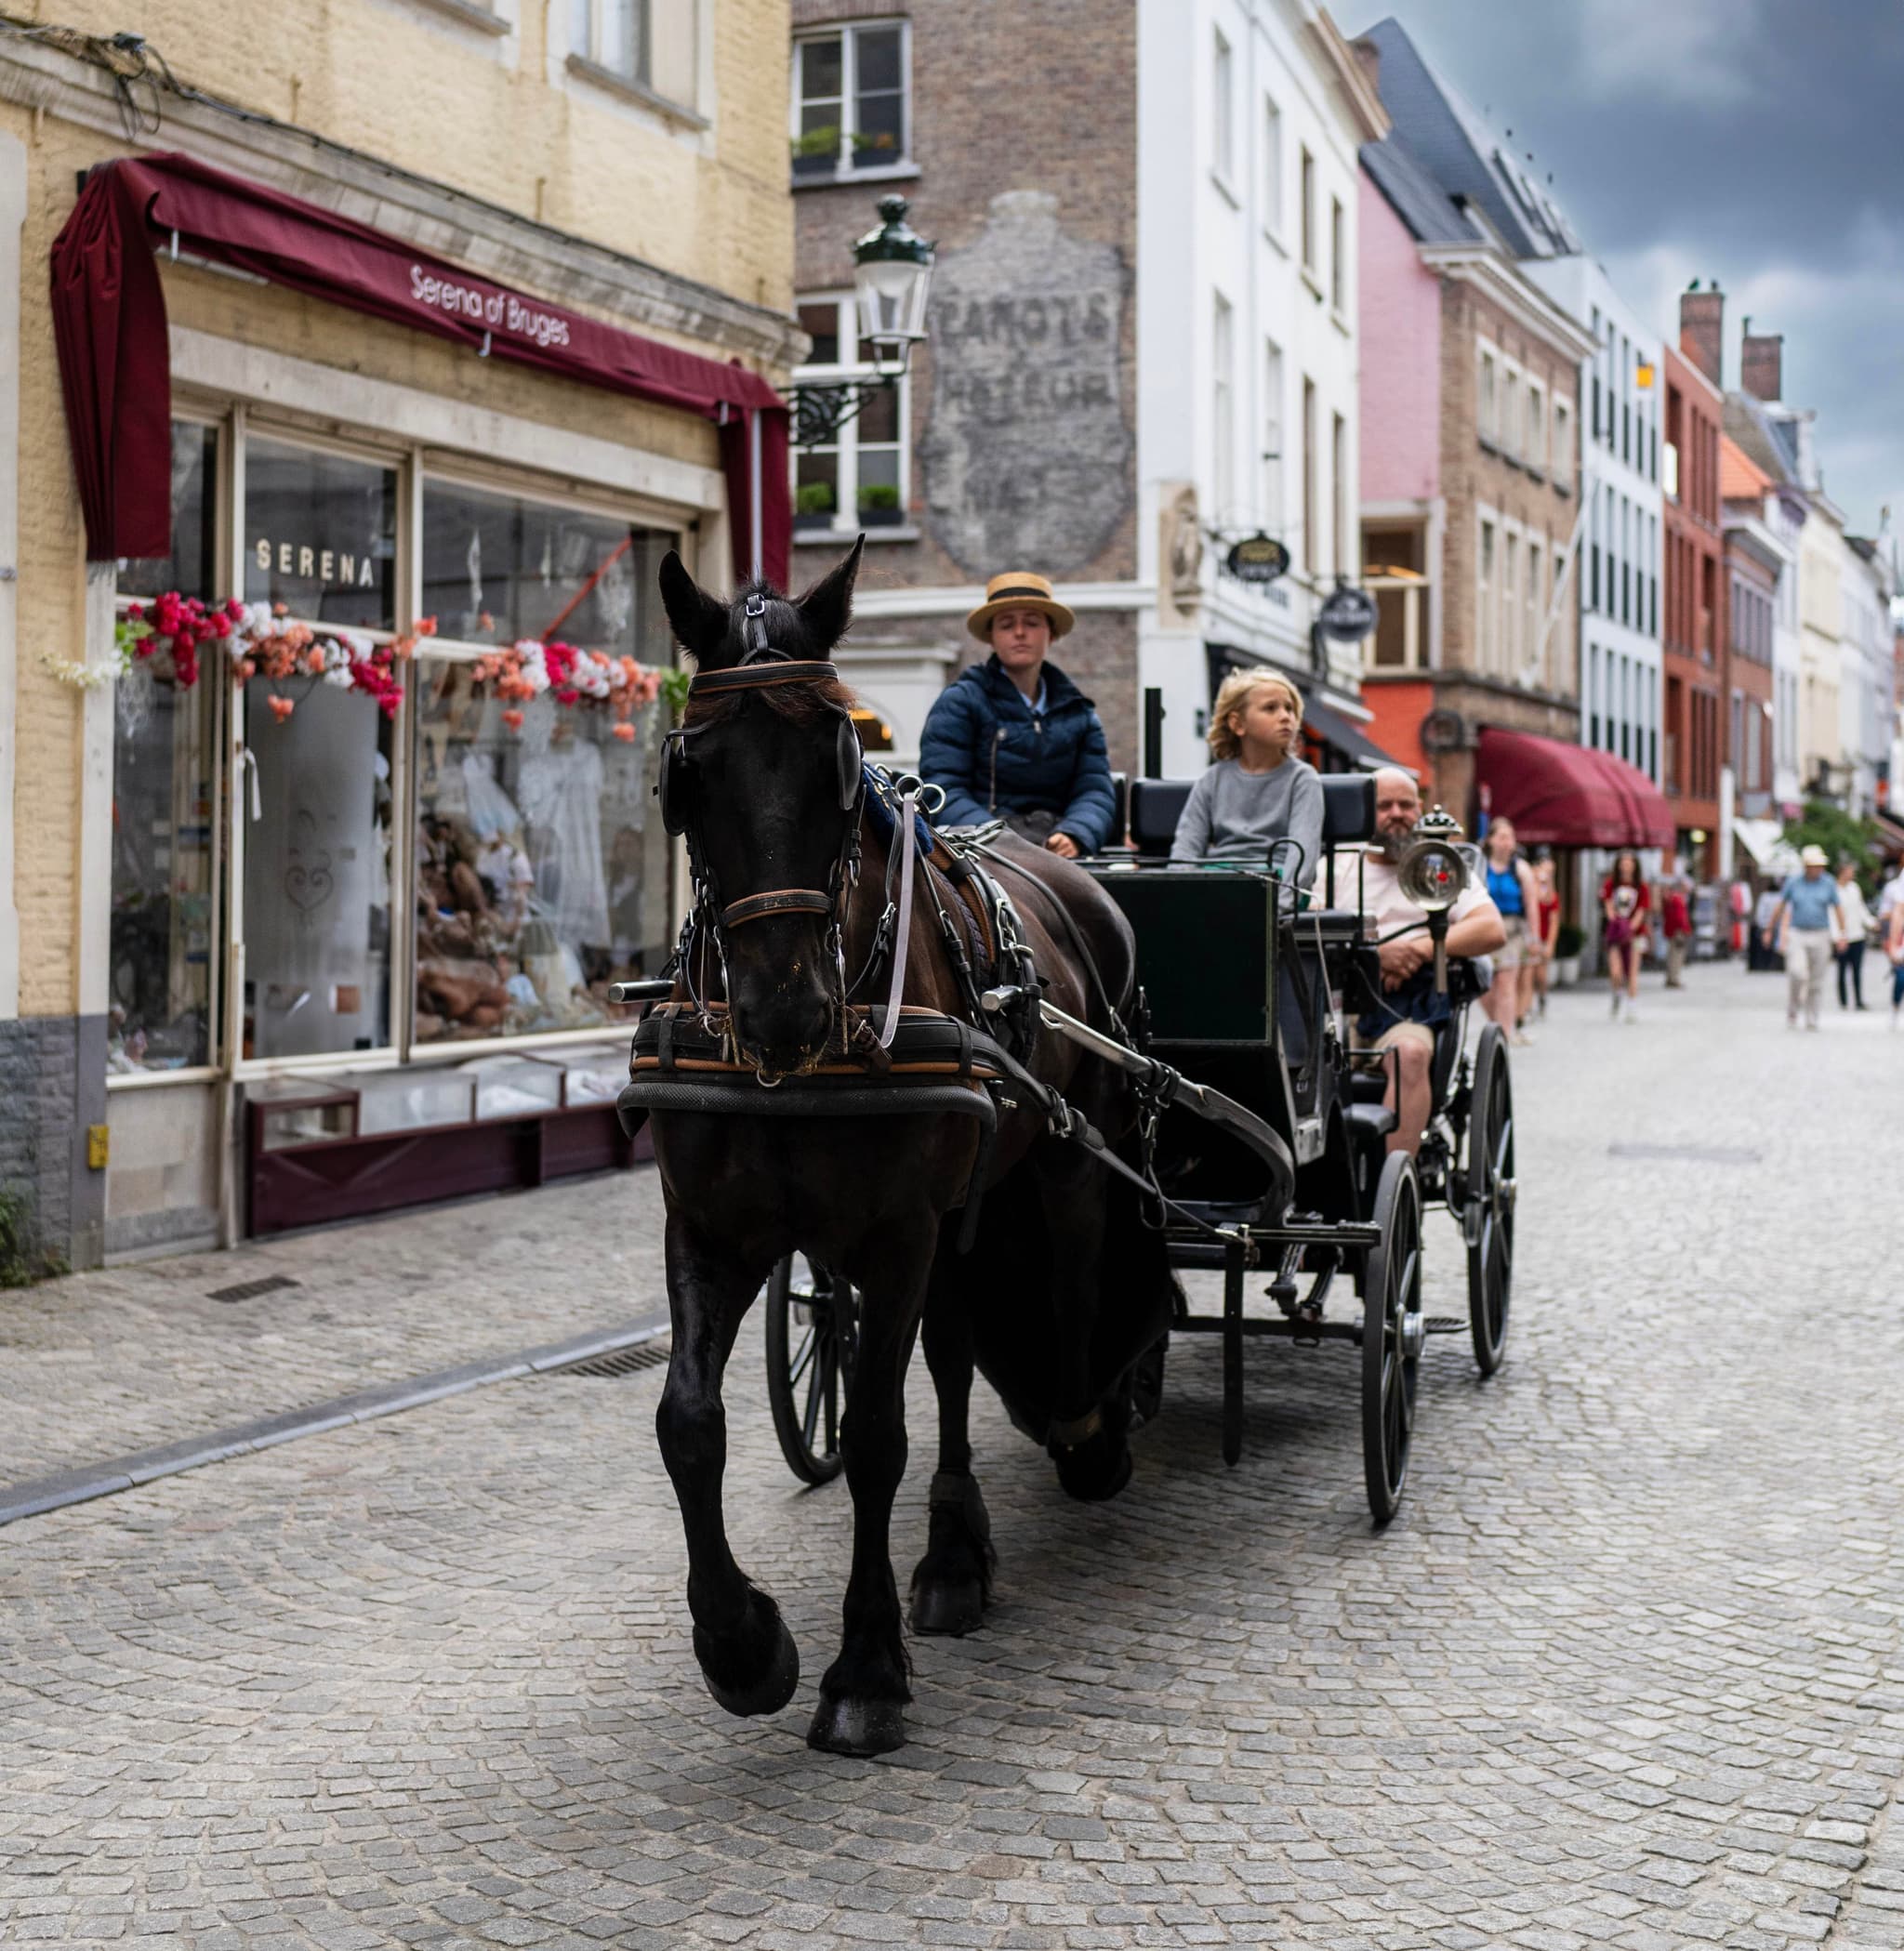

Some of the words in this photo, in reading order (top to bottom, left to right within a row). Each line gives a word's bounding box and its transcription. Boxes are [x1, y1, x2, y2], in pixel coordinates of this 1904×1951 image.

[410, 265, 483, 318] Serena
[484, 294, 505, 324] of
[507, 297, 570, 347] Bruges
[257, 537, 374, 587] SERENA
